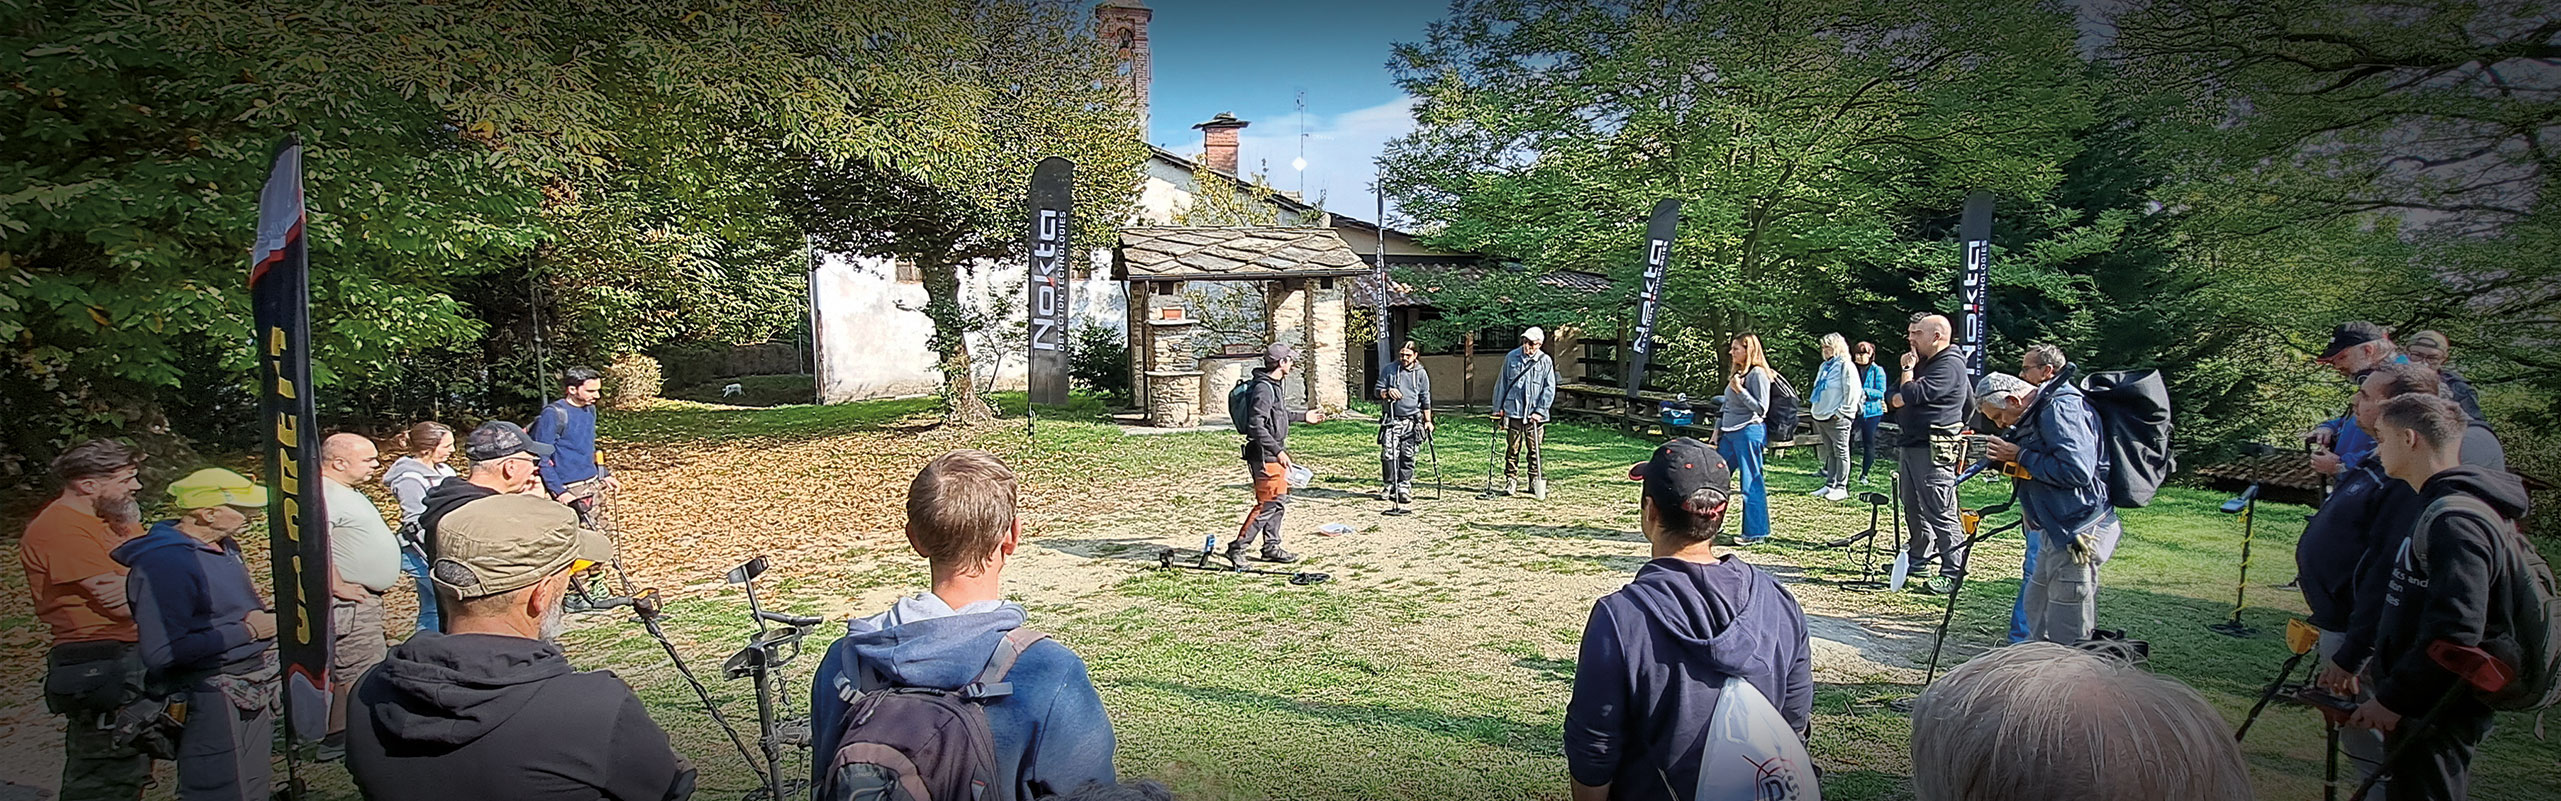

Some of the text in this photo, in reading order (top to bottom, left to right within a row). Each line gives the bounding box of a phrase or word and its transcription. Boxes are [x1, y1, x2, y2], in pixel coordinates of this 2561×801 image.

[1033, 209, 1056, 351] Nokta
[1057, 211, 1067, 351] DETECTION TECHNOLOGIES
[1633, 239, 1664, 354] Nokta
[1976, 240, 1988, 376] DETECTION TECHNOLOGIES
[2407, 576, 2430, 588] and
